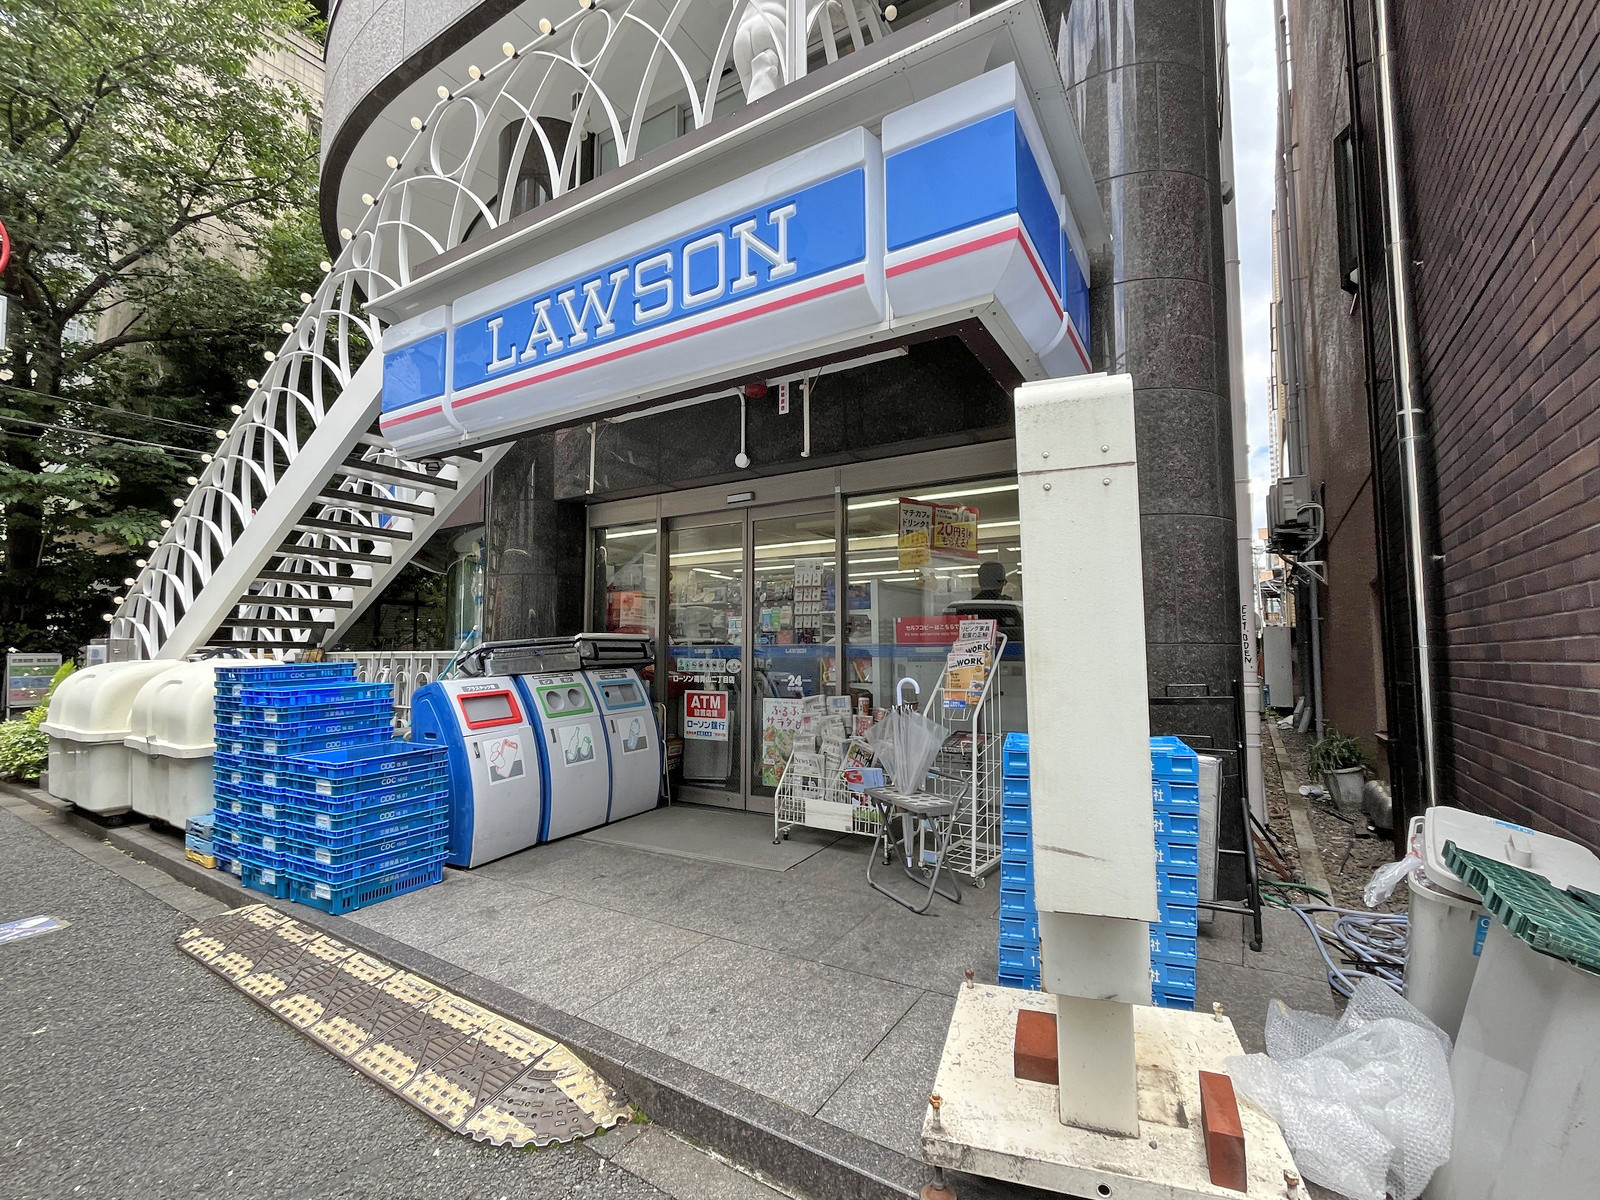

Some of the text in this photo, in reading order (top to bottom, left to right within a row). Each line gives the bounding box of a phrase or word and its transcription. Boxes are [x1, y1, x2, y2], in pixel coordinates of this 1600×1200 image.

[486, 203, 797, 373] LAWSON
[957, 657, 984, 667] WORK
[787, 675, 803, 687] 24
[691, 695, 720, 709] ATM
[326, 725, 341, 733] CDC
[687, 720, 725, 730] ローソン銀行
[380, 761, 396, 770] CDC
[381, 777, 397, 785] CDC
[380, 794, 396, 803] CDC
[379, 811, 395, 820] CDC
[380, 842, 396, 851] CDC
